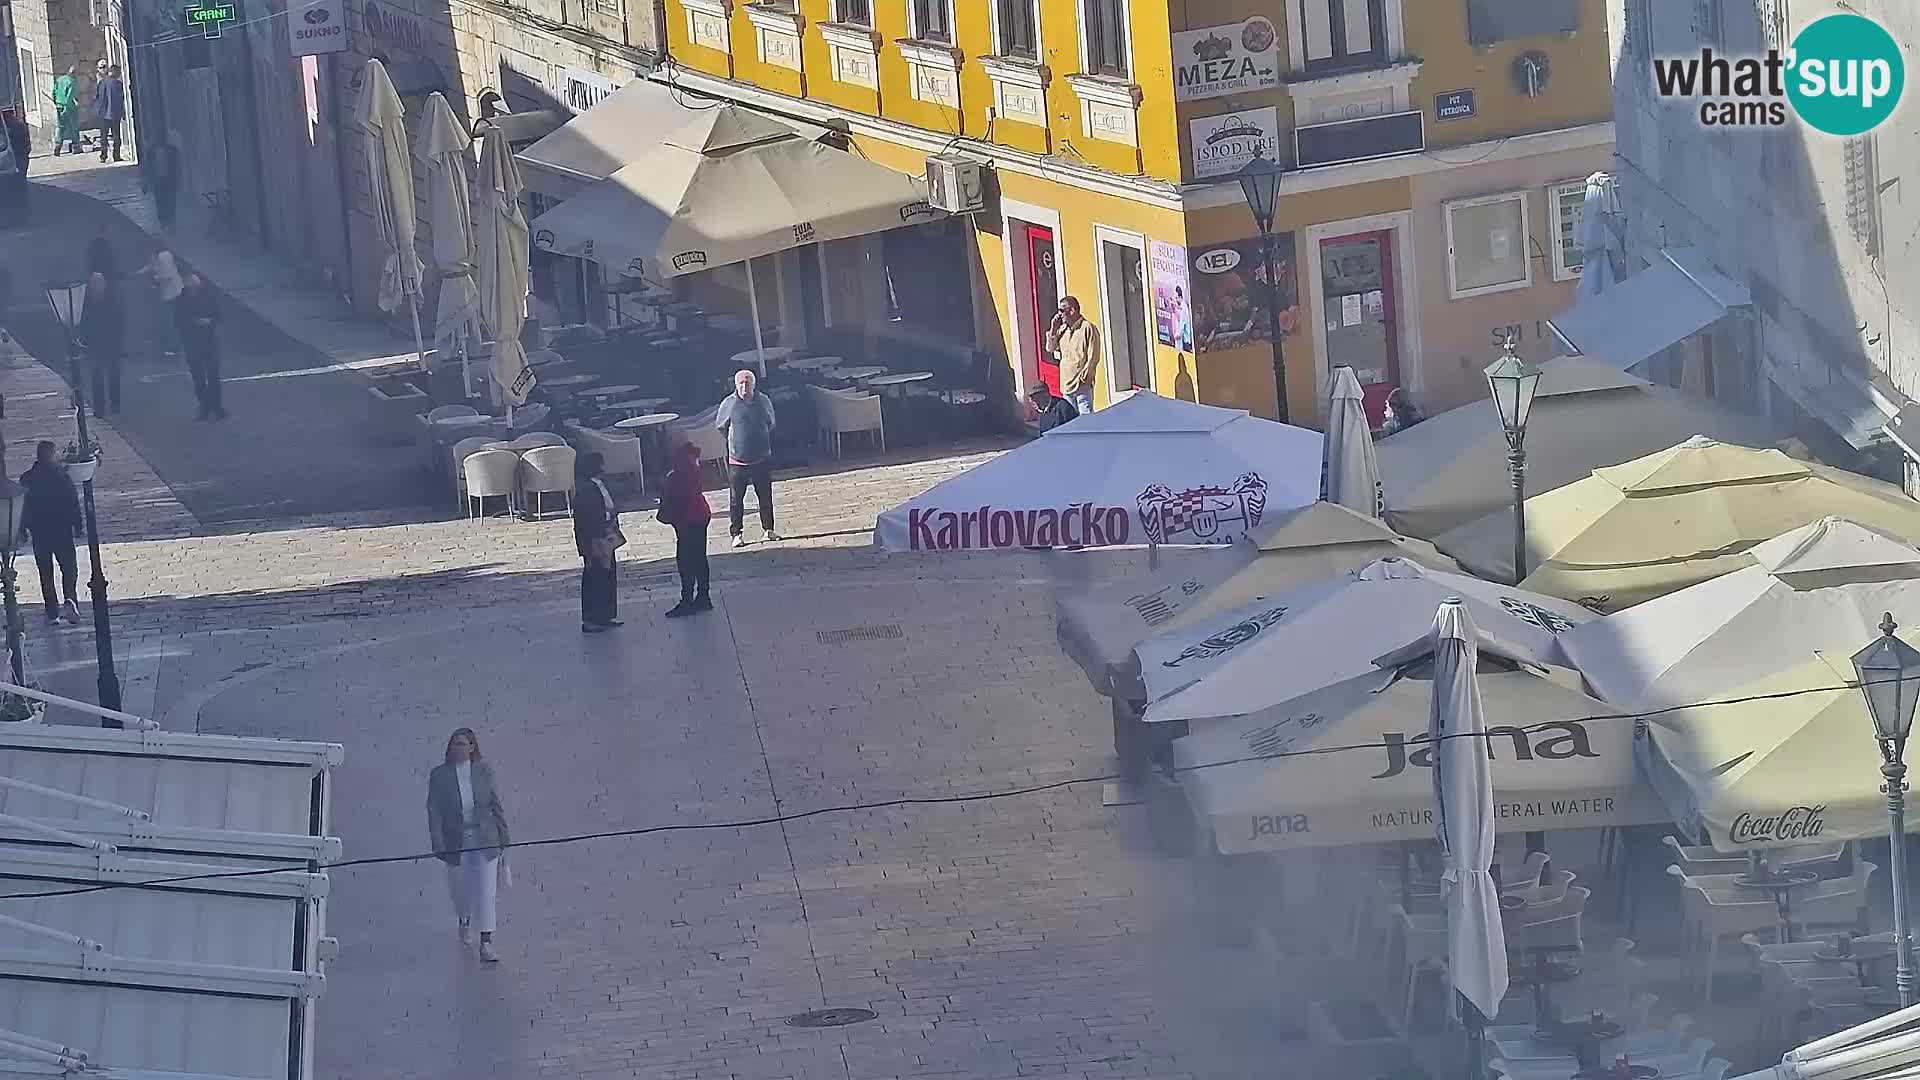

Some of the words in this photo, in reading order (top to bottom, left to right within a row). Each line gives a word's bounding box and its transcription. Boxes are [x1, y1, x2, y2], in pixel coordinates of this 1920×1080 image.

[296, 26, 340, 40] SUKNO
[1178, 56, 1257, 87] MEZA
[1187, 82, 1220, 96] PIZZERIA
[1221, 81, 1228, 90] &
[1228, 79, 1248, 90] GRILL
[1197, 142, 1242, 161] ISPOD
[908, 502, 1130, 550] Karlovačko
[1372, 811, 1433, 828] NATUR
[1552, 797, 1615, 816] WATER
[1730, 804, 1827, 844] Coca-Cola
